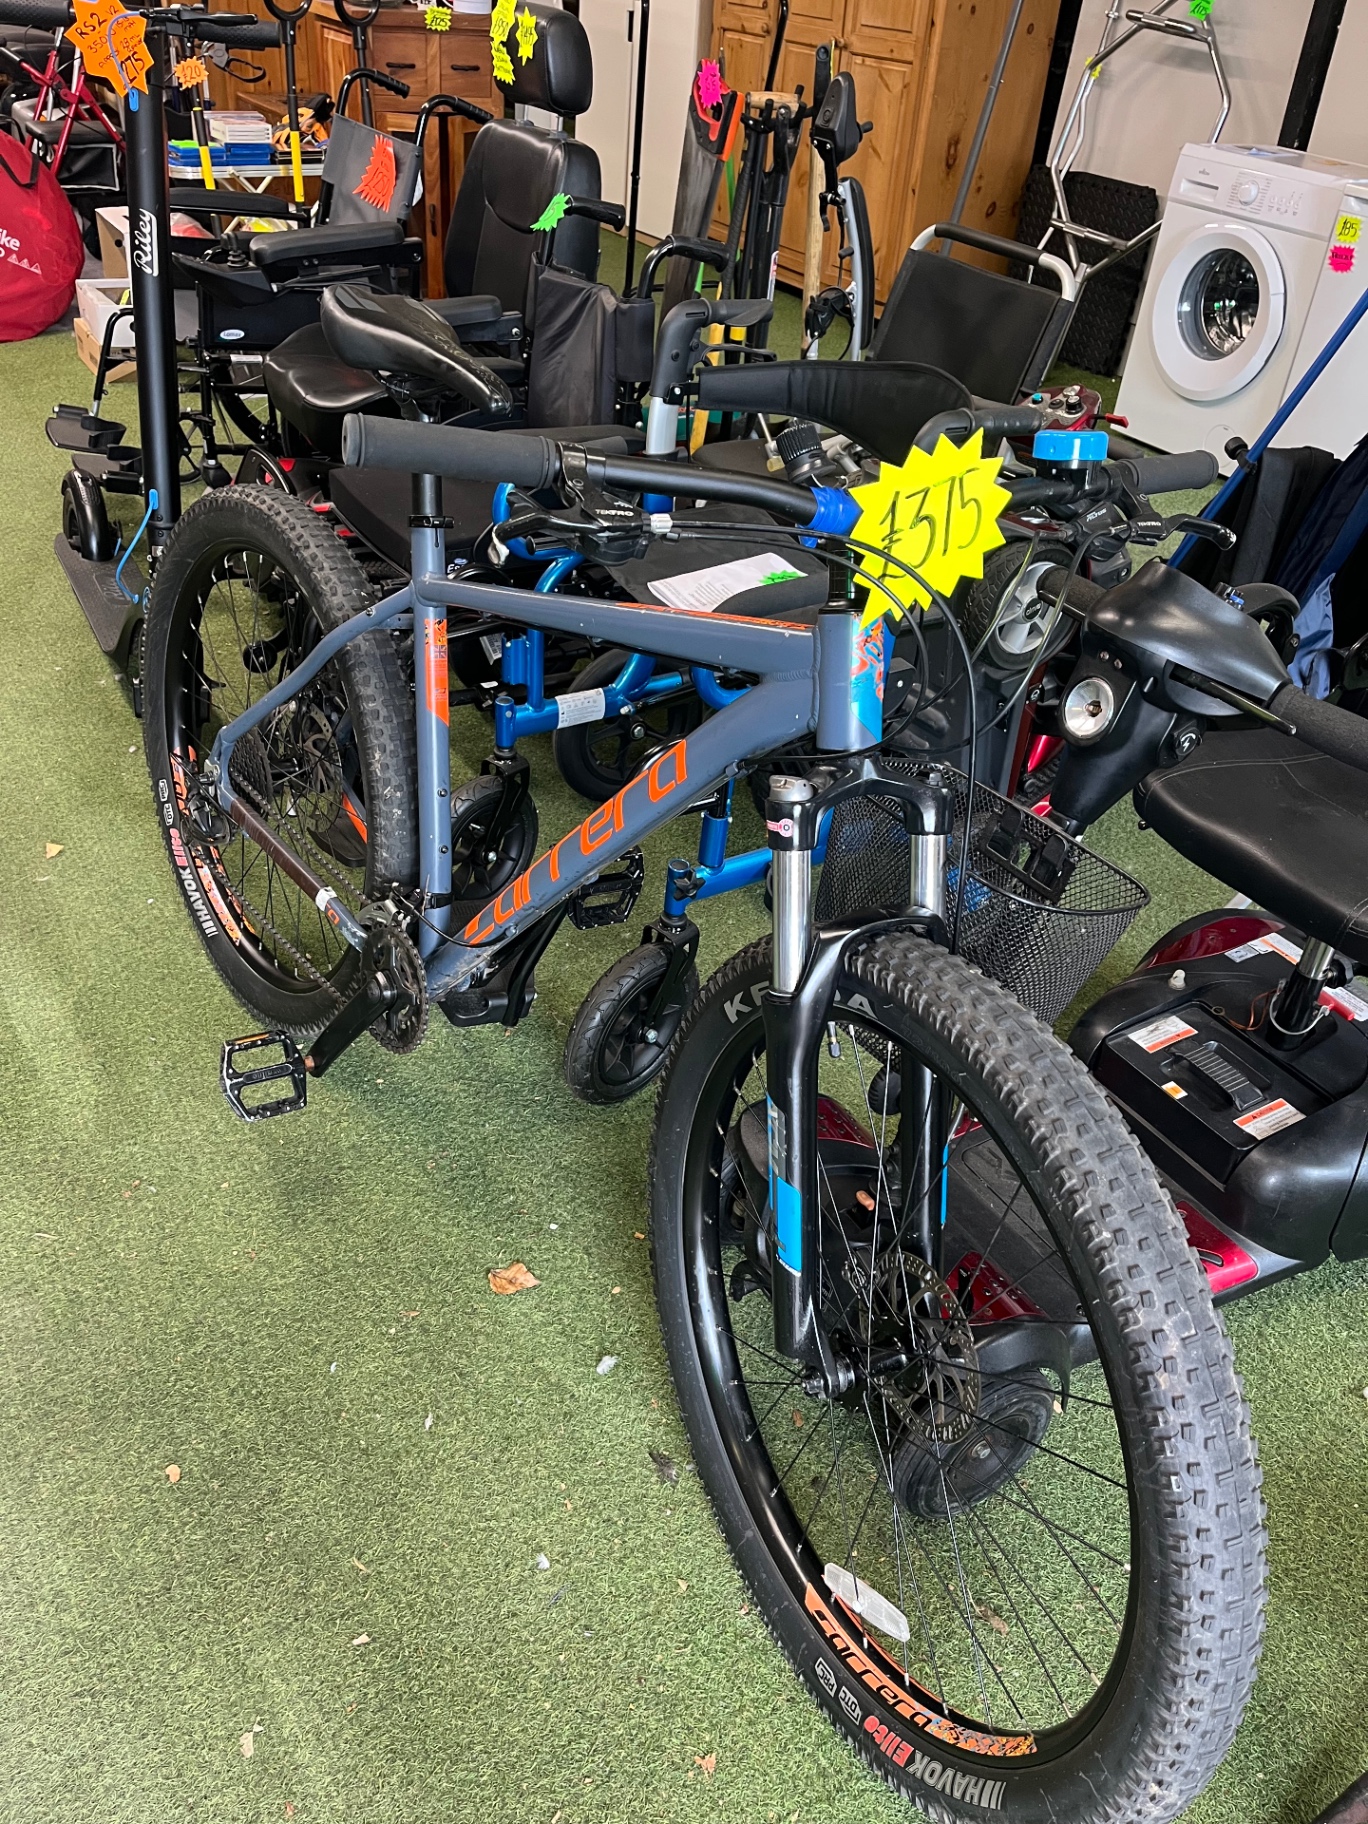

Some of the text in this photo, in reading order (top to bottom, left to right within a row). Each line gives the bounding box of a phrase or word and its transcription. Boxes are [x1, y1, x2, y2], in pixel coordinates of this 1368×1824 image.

[75, 12, 107, 40] RS2
[181, 65, 201, 85] £20
[133, 208, 159, 277] Riley
[595, 508, 634, 517] TEKTRO
[464, 739, 688, 945] carrera
[180, 866, 212, 924] HAVOK
[813, 1609, 934, 1730] carrera
[815, 1666, 836, 1691] PRC
[839, 1687, 859, 1712] DTC
[863, 1715, 985, 1810] HAVOK Elite
